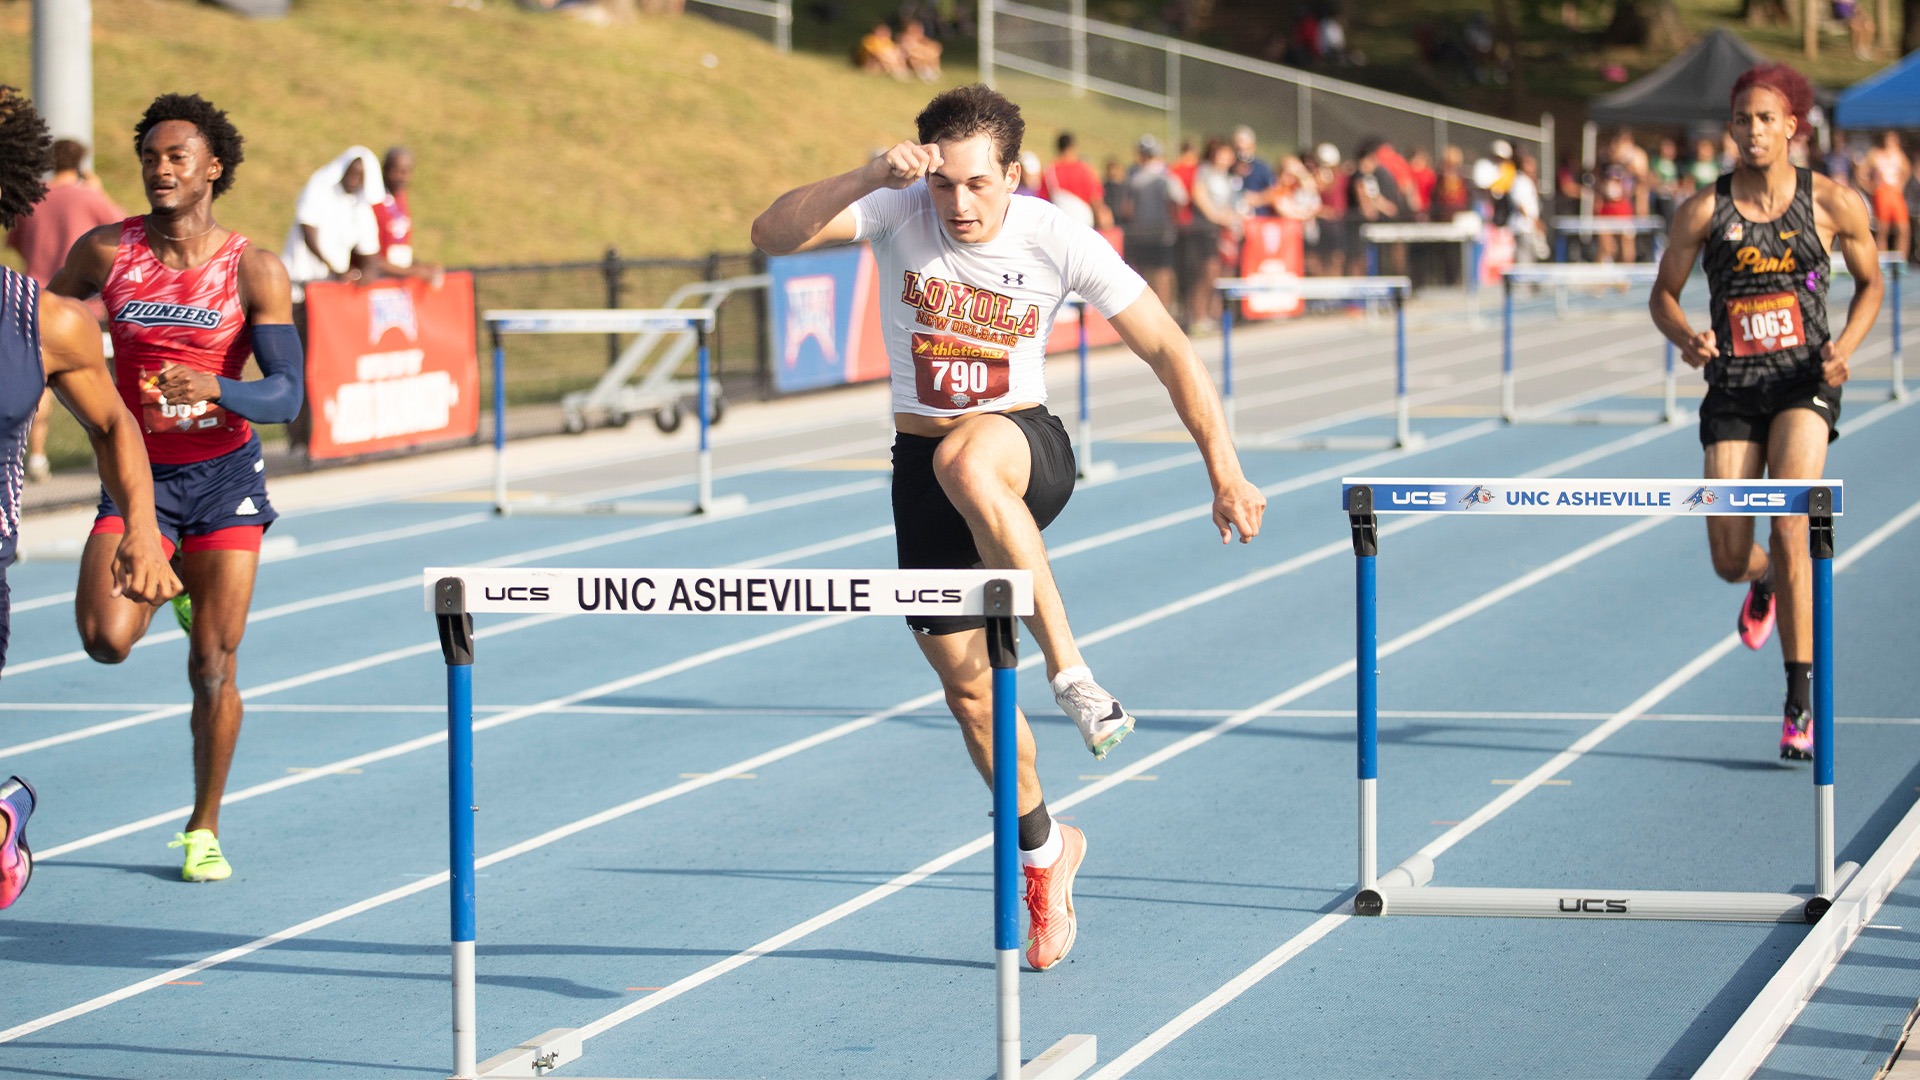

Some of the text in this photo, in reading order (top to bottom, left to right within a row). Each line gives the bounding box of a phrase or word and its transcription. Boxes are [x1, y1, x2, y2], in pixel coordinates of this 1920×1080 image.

[1732, 246, 1796, 274] Park
[117, 301, 220, 327] PIONEERS
[901, 270, 1040, 338] LOYOLA
[915, 310, 1019, 347] NEW ORLEANS
[1740, 308, 1794, 341] 1063
[931, 361, 988, 393] 790
[1392, 491, 1786, 507] UCS UNC ASHEVILLE UCS
[485, 577, 962, 612] UCS UNC ASHEVILLE UCS
[1559, 898, 1627, 913] UCS
